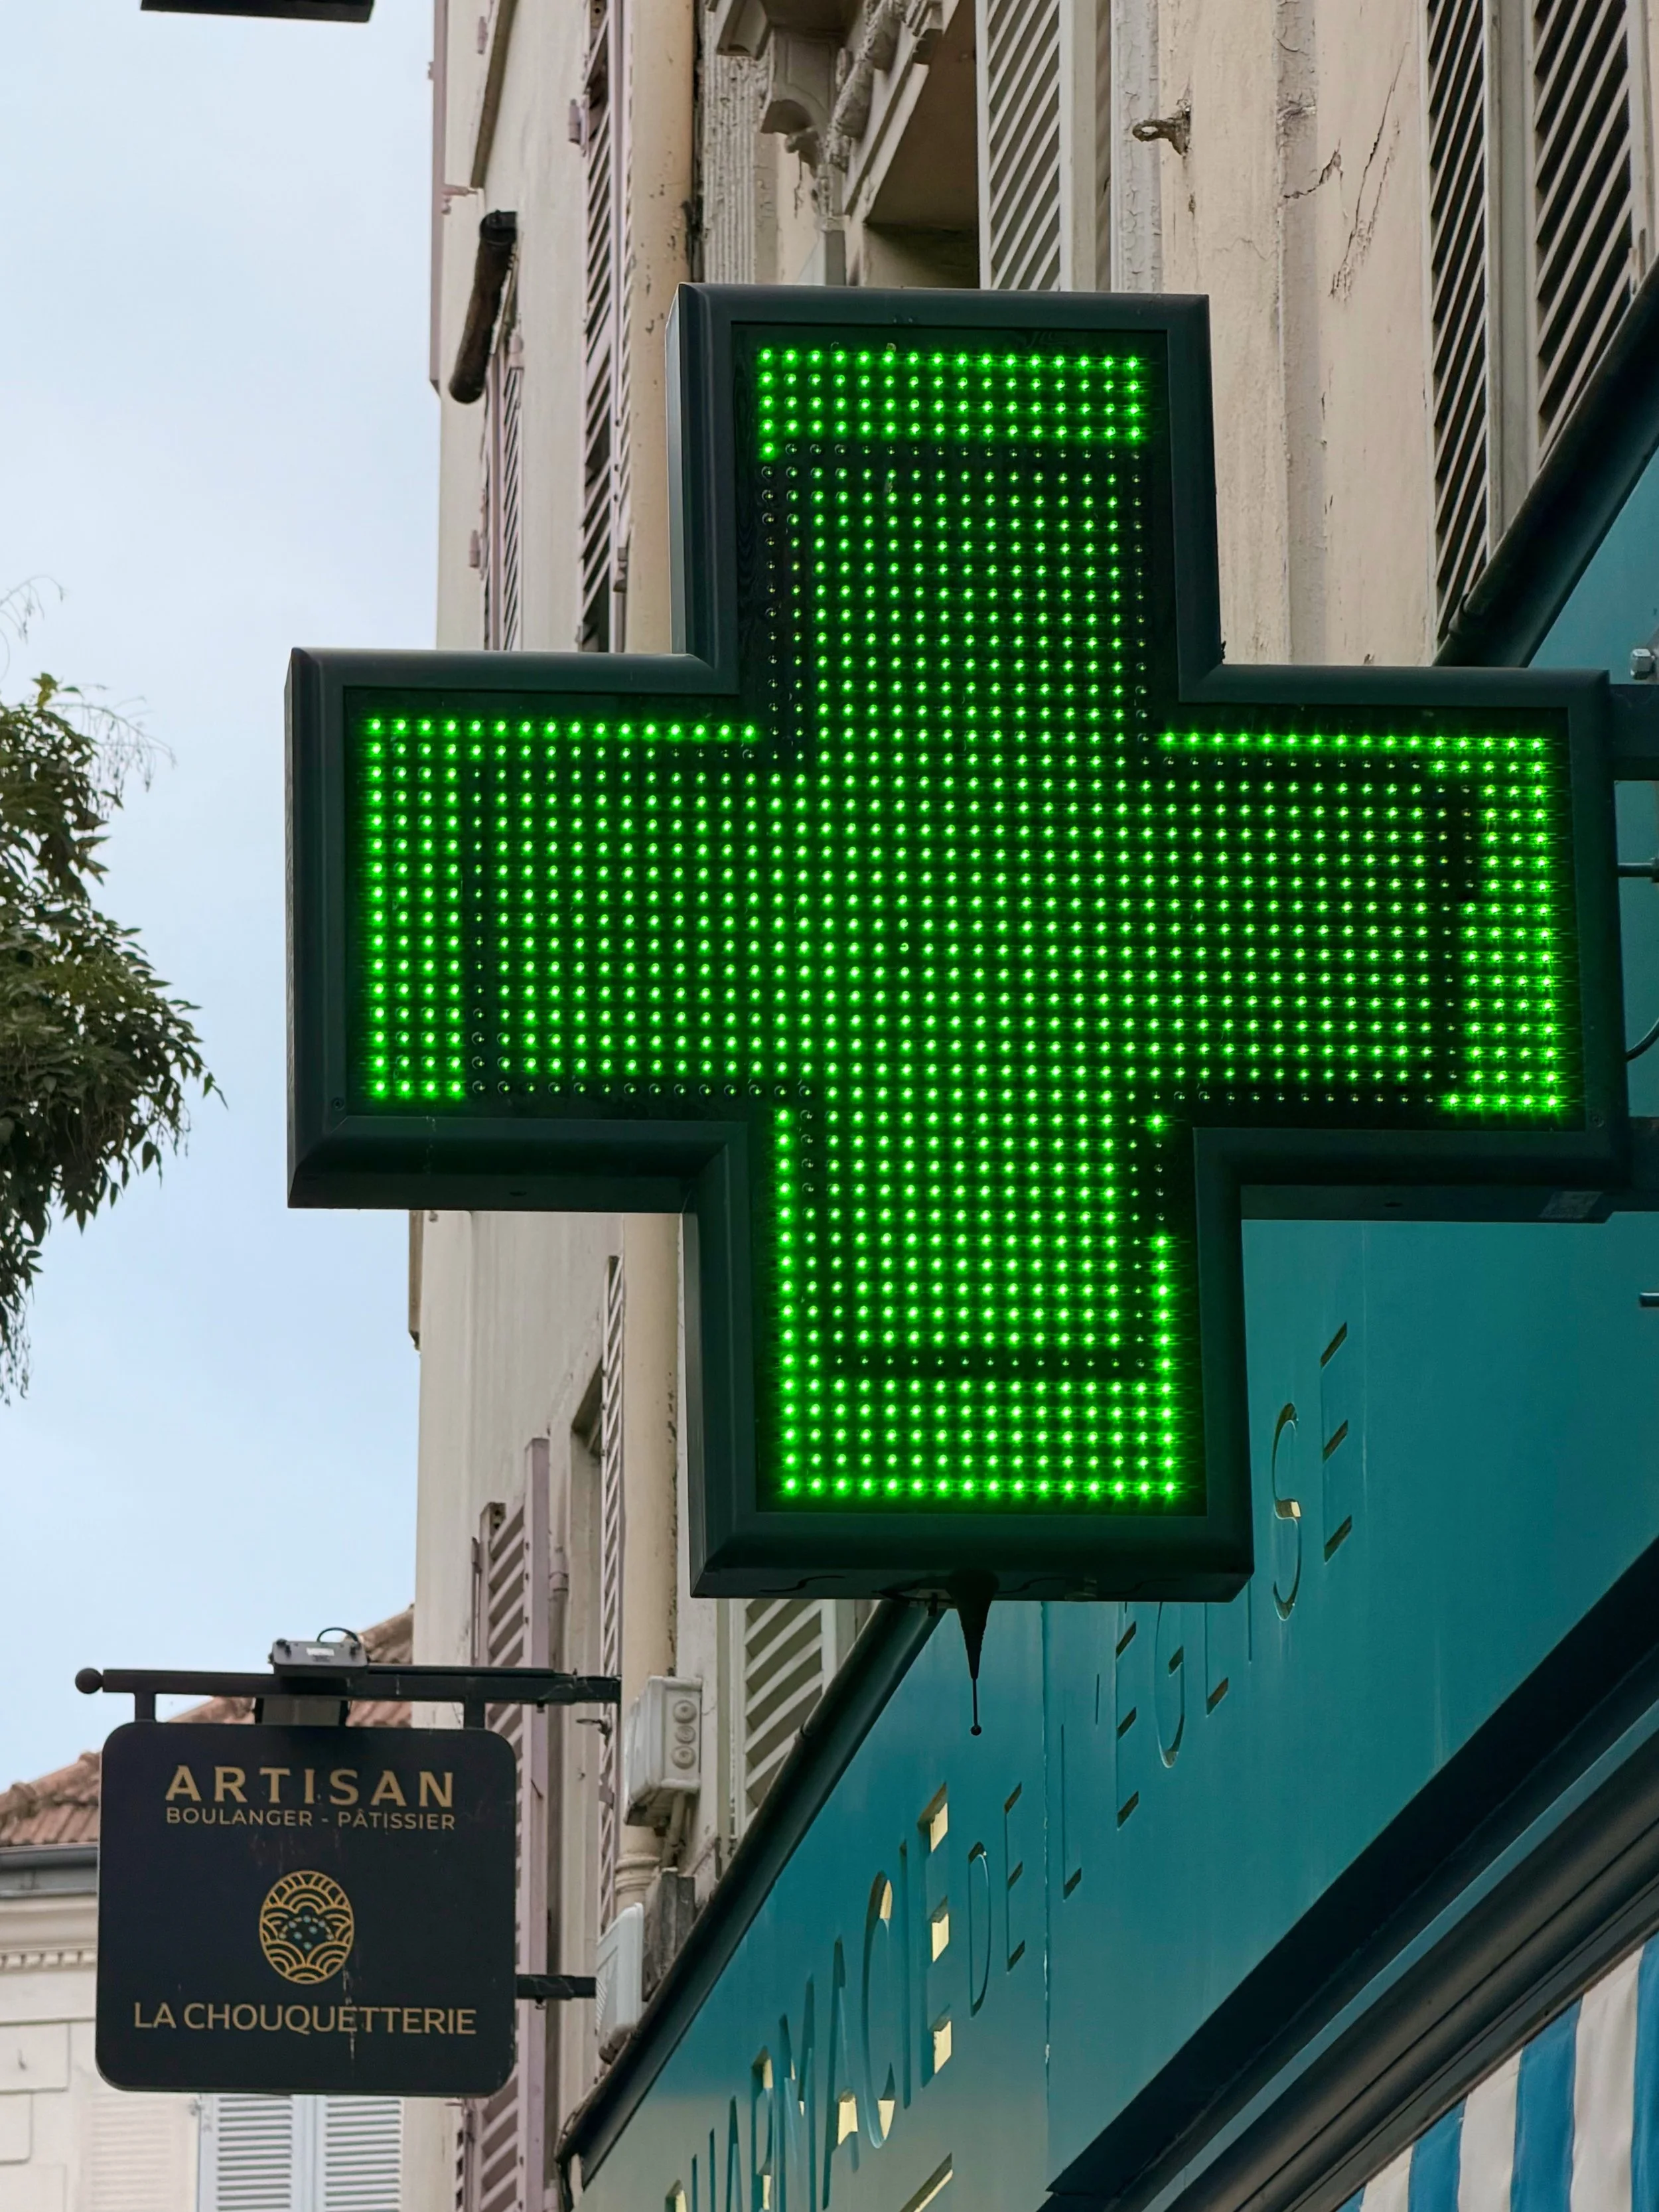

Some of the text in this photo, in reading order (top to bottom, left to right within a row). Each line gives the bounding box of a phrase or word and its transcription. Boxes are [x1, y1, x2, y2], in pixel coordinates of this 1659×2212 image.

[165, 1765, 453, 1807] ARTISAN
[167, 1807, 313, 1826] BOULANGER
[338, 1808, 455, 1830] PÂTISSIER
[665, 1783, 953, 2212] ARMACIE
[969, 1782, 1026, 2018] DE
[134, 2002, 476, 2035] LA CHOUQUETTERIE
